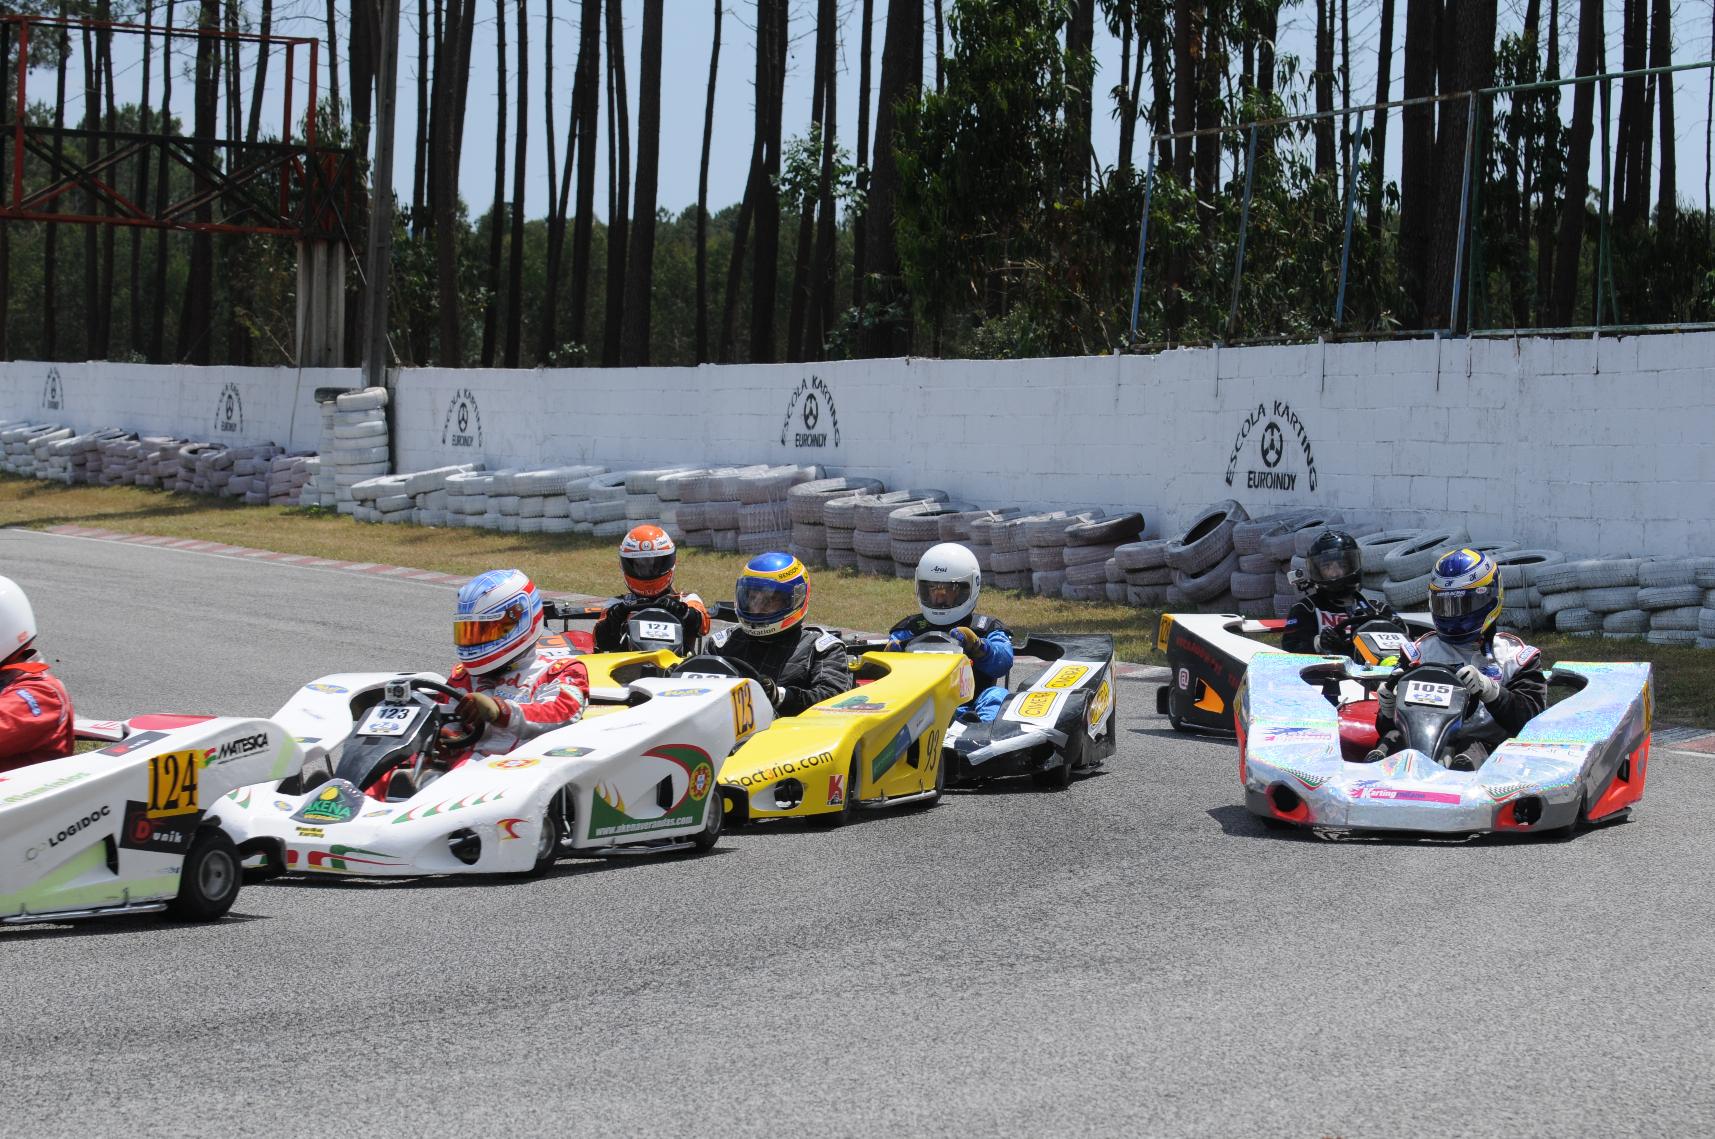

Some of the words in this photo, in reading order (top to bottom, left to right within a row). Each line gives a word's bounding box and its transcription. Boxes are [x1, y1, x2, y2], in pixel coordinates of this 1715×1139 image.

[781, 378, 808, 446] ESCOLA
[812, 375, 841, 448] KARTING
[795, 432, 828, 448] EUROINDY
[1225, 403, 1266, 487] ESCOLA
[1273, 399, 1318, 492] KARTING
[1247, 470, 1297, 491] EUROINDY
[648, 623, 668, 631] 127
[1377, 633, 1401, 641] 128
[1411, 682, 1450, 694] 105
[378, 708, 410, 720] 123
[733, 682, 755, 736] 123
[924, 729, 940, 773] 93
[148, 753, 198, 811] 124
[303, 800, 352, 817] AKENA
[49, 805, 111, 848] LOGIDOC
